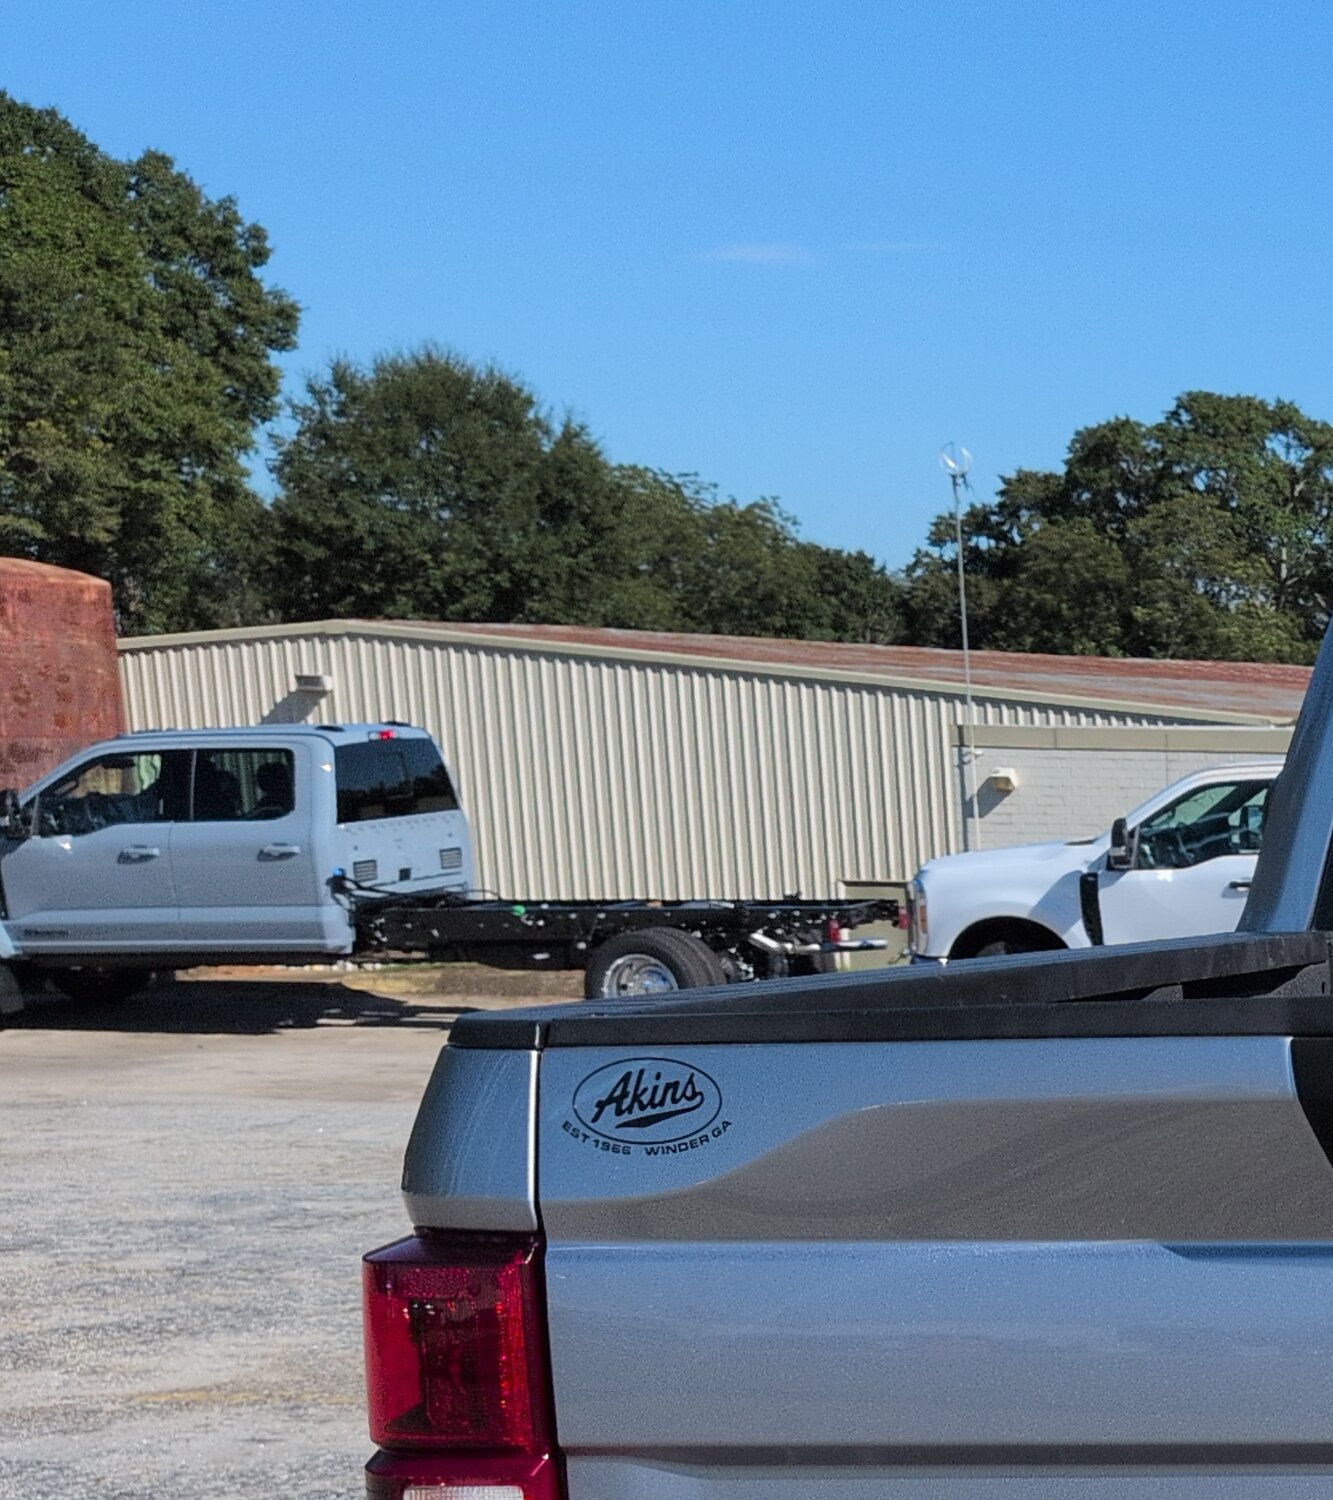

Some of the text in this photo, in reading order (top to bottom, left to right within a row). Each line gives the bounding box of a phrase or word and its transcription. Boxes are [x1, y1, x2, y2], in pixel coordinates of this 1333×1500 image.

[591, 1068, 706, 1126] Akins
[562, 1120, 591, 1143] EST
[644, 1134, 710, 1156] WINDER
[711, 1120, 733, 1139] GA
